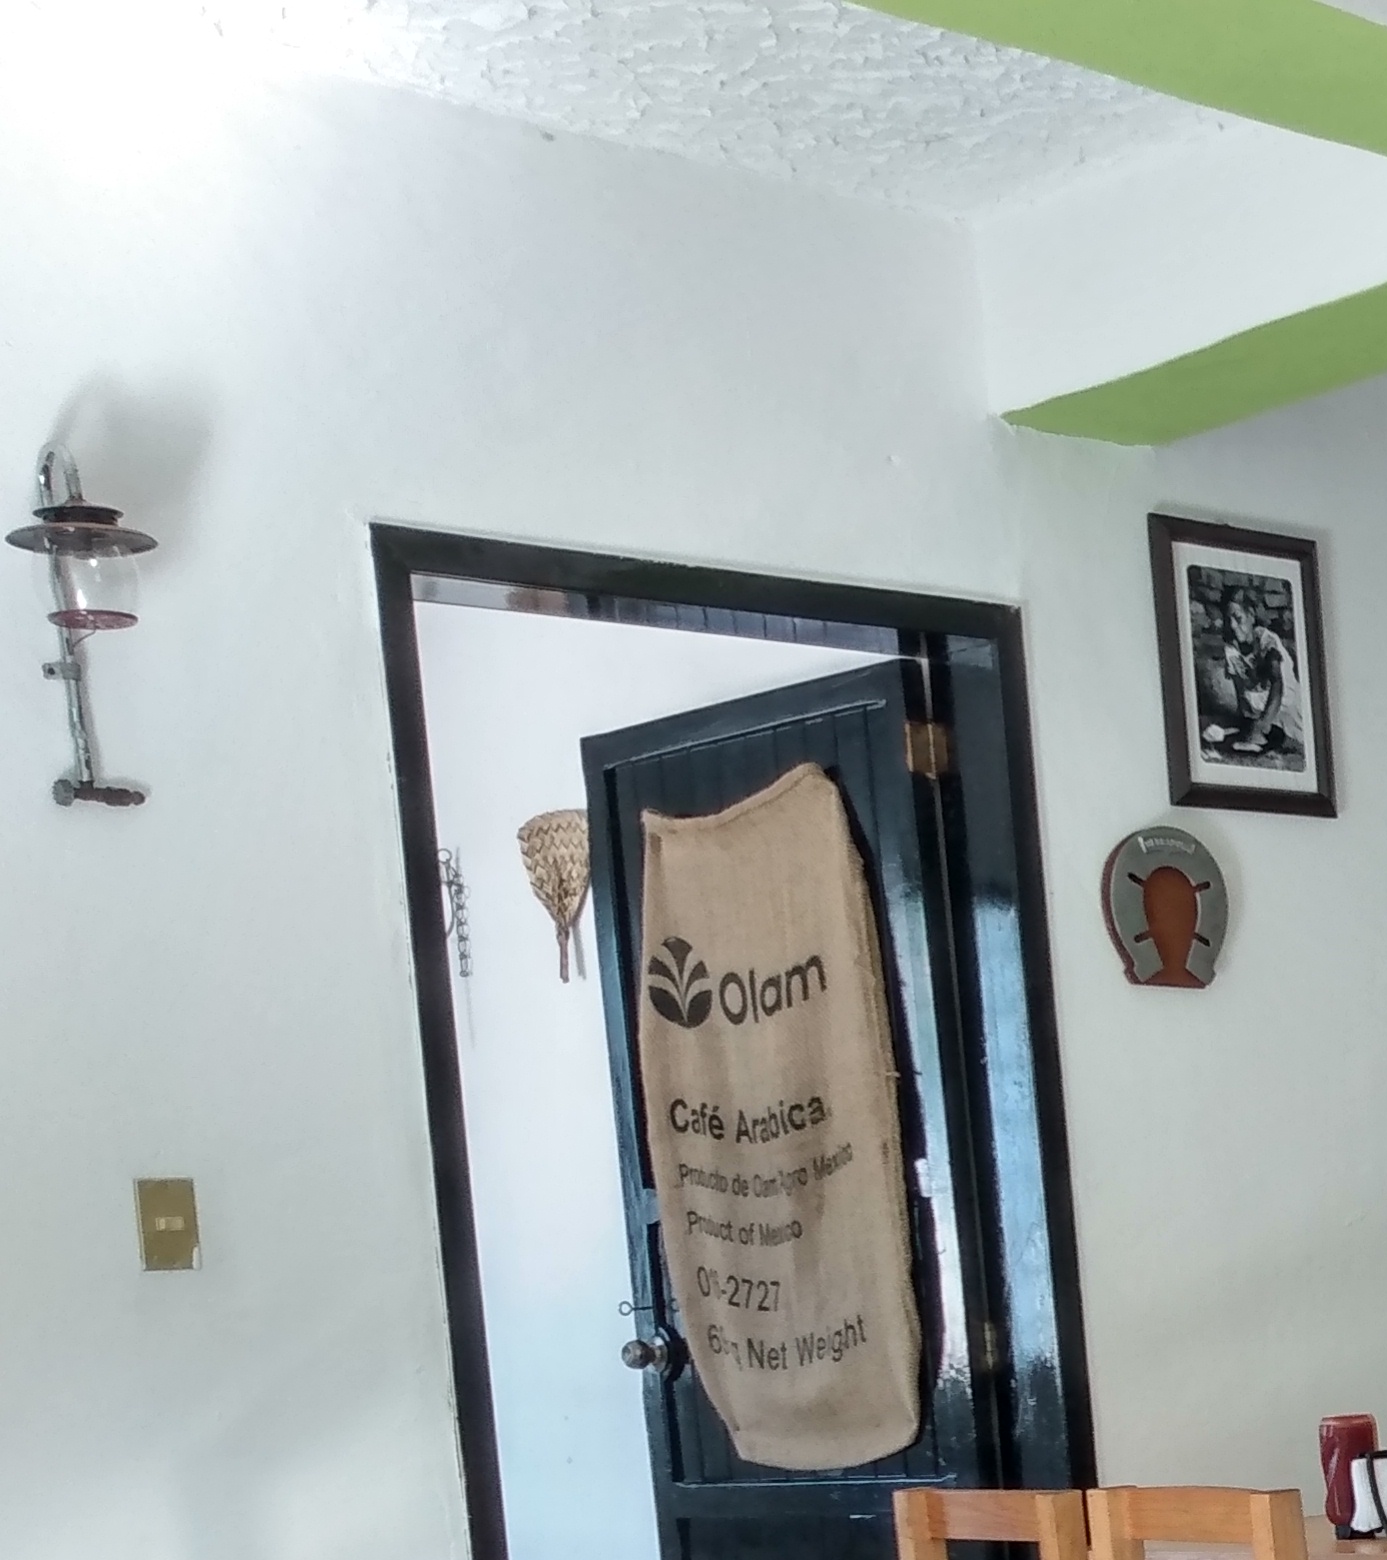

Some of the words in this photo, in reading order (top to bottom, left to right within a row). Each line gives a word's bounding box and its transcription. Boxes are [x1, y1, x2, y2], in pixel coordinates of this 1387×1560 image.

[719, 954, 827, 1025] Olam
[669, 1098, 725, 1140] Café
[735, 1096, 826, 1143] Arabica
[732, 1173, 749, 1197] de
[739, 1222, 755, 1245] of
[747, 1337, 788, 1370] Net
[794, 1314, 867, 1367] Weight
